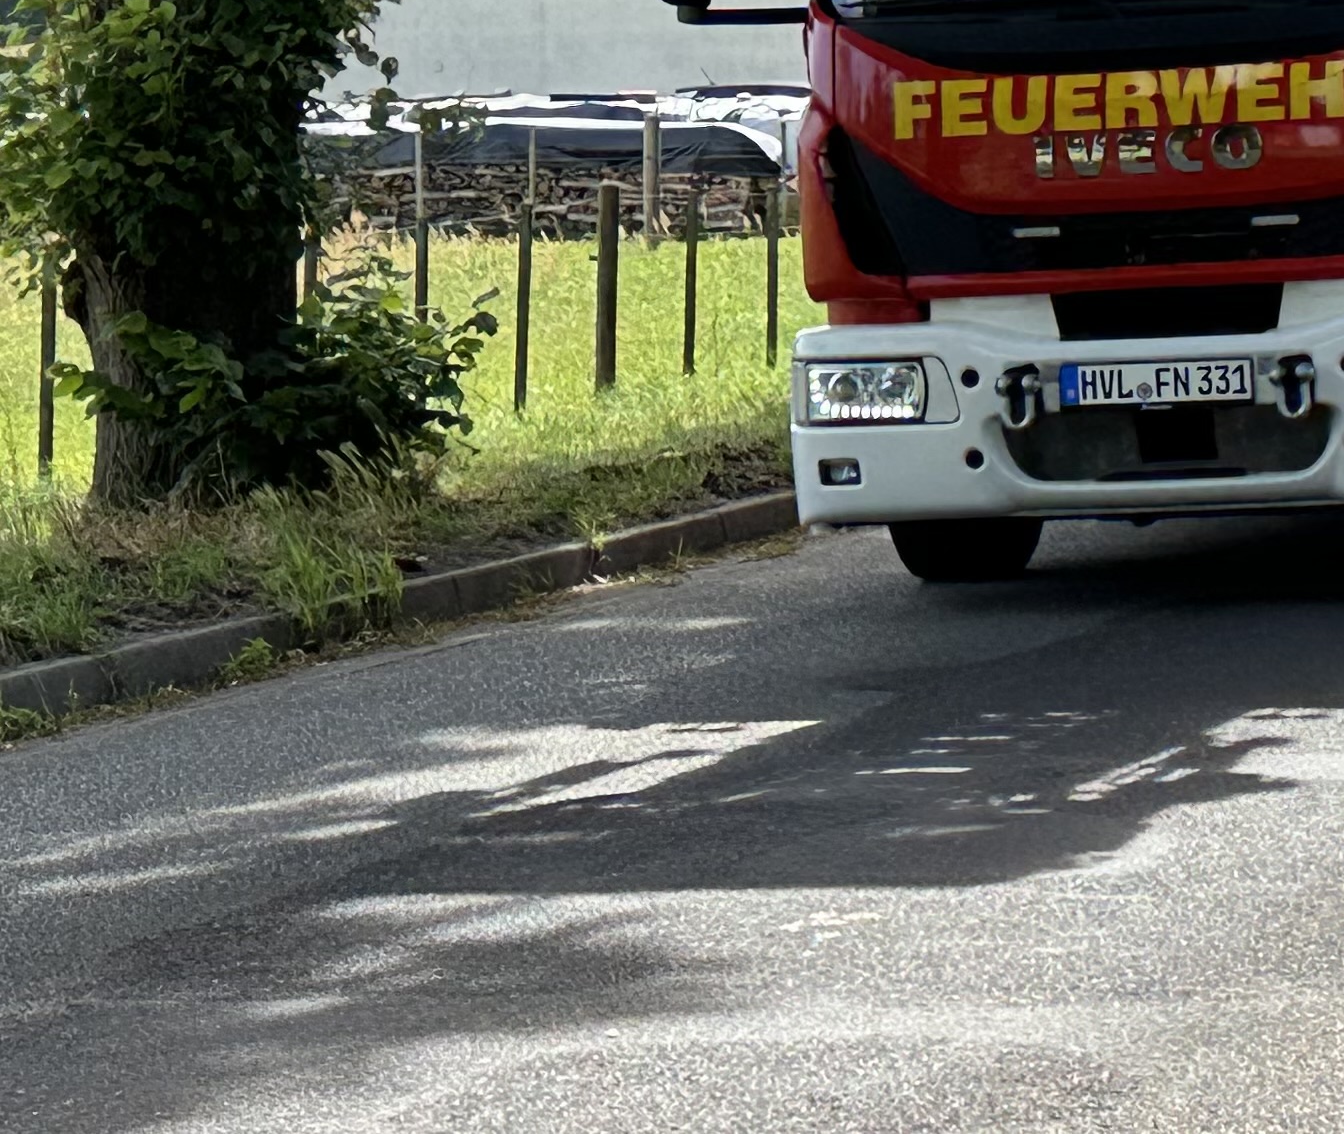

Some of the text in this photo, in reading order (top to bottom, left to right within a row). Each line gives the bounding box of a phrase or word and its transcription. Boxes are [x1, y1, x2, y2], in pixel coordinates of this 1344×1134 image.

[1033, 124, 1263, 180] IVECO
[1081, 364, 1248, 400] HVL FN 331
